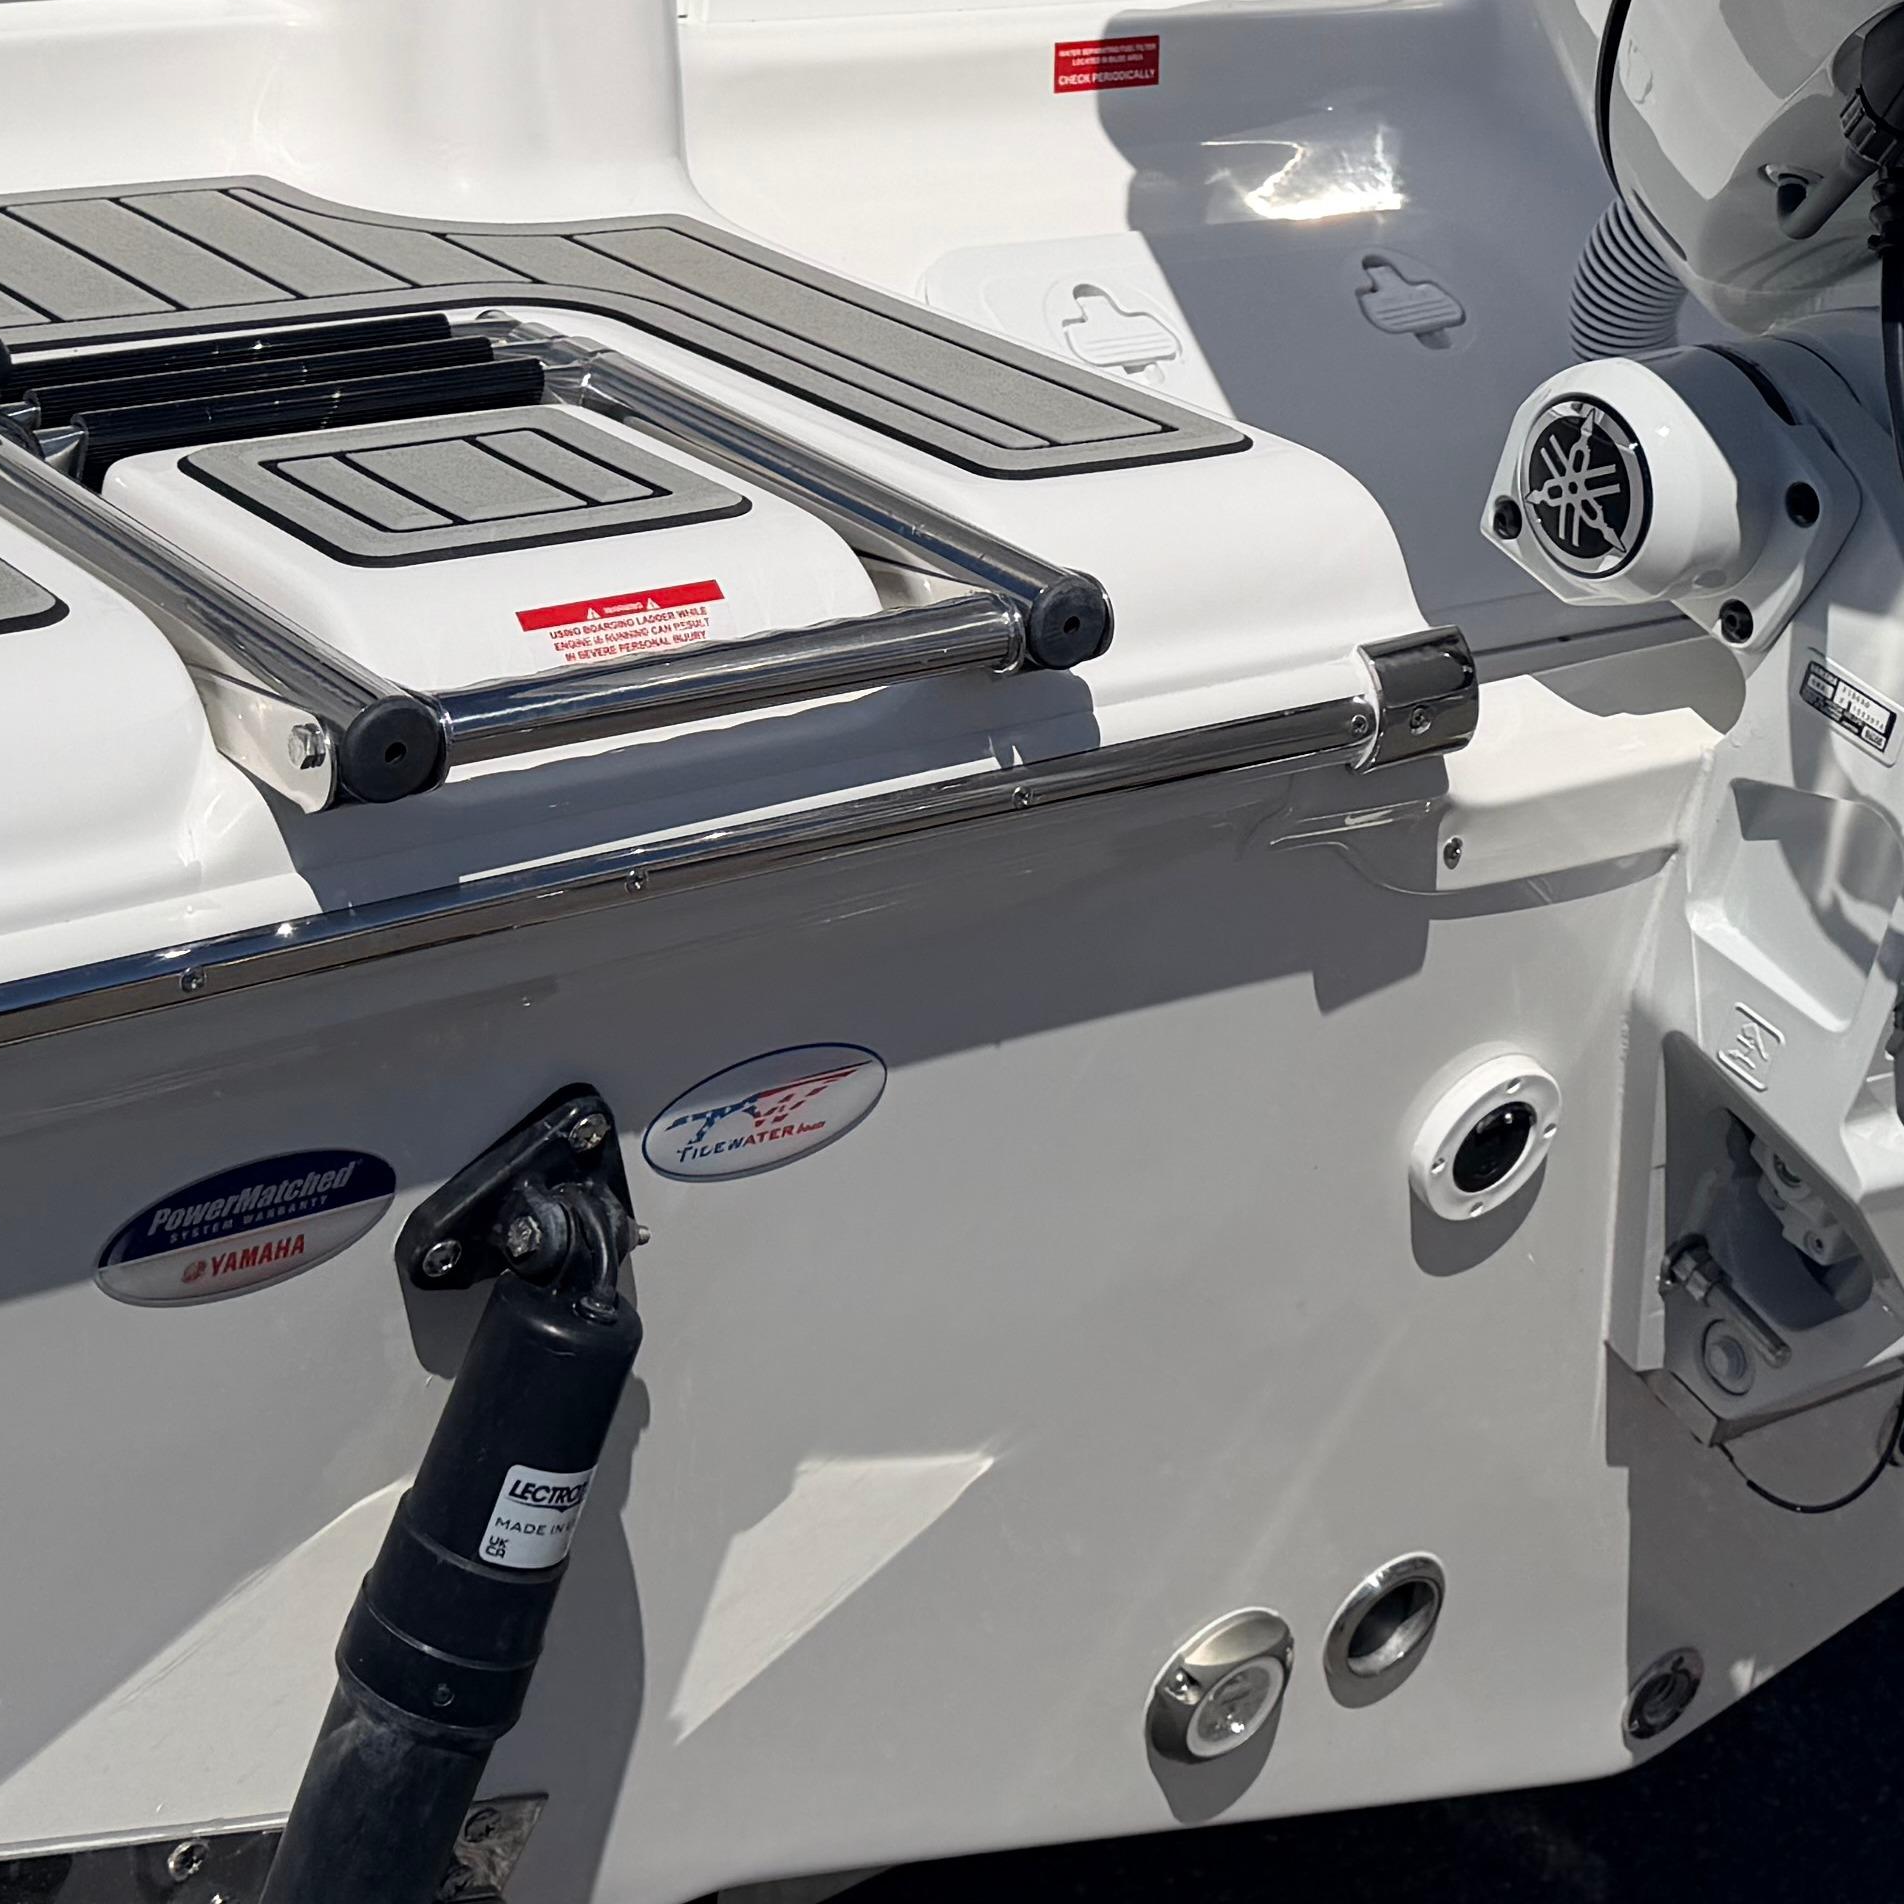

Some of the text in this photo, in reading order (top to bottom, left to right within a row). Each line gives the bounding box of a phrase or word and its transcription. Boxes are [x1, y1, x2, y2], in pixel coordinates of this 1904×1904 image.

[1058, 68, 1156, 86] CHECK PERIODICALLY
[549, 606, 708, 640] USING BOARDING LADDER WHILE
[554, 637, 593, 652] ENGINE
[604, 627, 649, 644] RUNNING
[650, 624, 672, 635] CAN
[673, 617, 710, 631] RESULT
[565, 630, 707, 662] IN SEVERE PERSONAL INJURY
[677, 1124, 796, 1163] TIDEWATER
[147, 1160, 357, 1237] PowerMatched
[169, 1194, 329, 1245] SYSTEM WARRANTY
[208, 1234, 306, 1277] YAMAHA
[509, 1479, 589, 1505] LECTRO
[489, 1535, 510, 1549] UK
[495, 1517, 547, 1536] MADE
[551, 1524, 565, 1536] IN
[485, 1546, 506, 1559] CA
